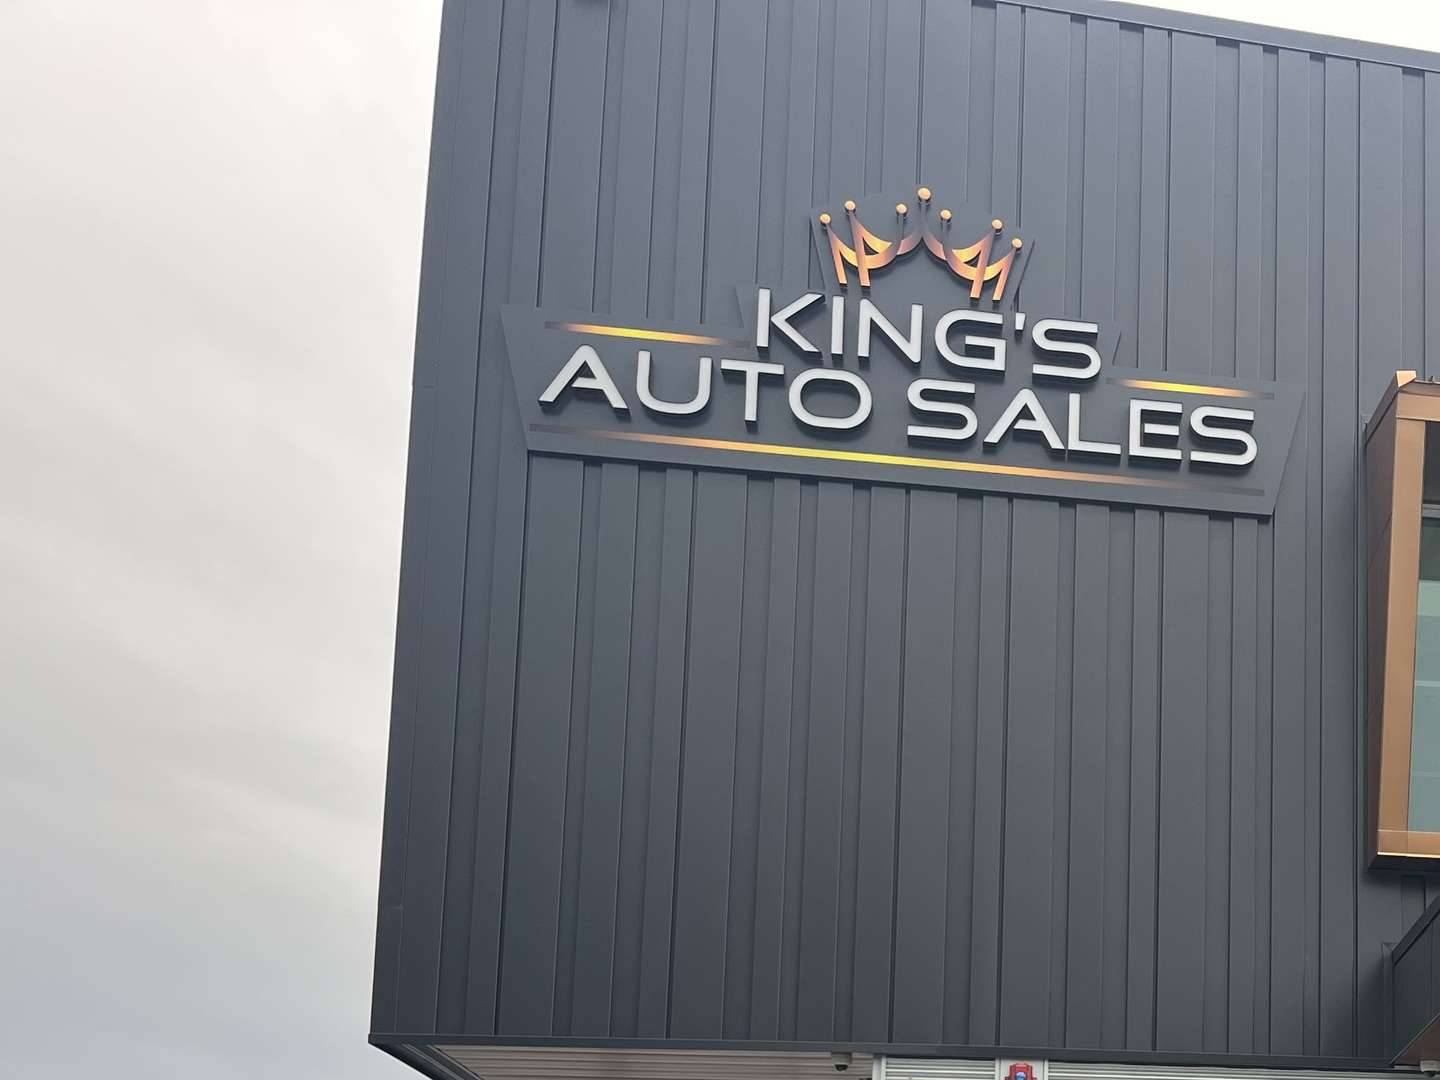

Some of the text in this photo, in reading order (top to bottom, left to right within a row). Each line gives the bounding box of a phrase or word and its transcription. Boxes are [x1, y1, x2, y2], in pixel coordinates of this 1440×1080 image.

[756, 287, 1103, 380] KING'S
[538, 344, 1259, 467] AUTO SALES
